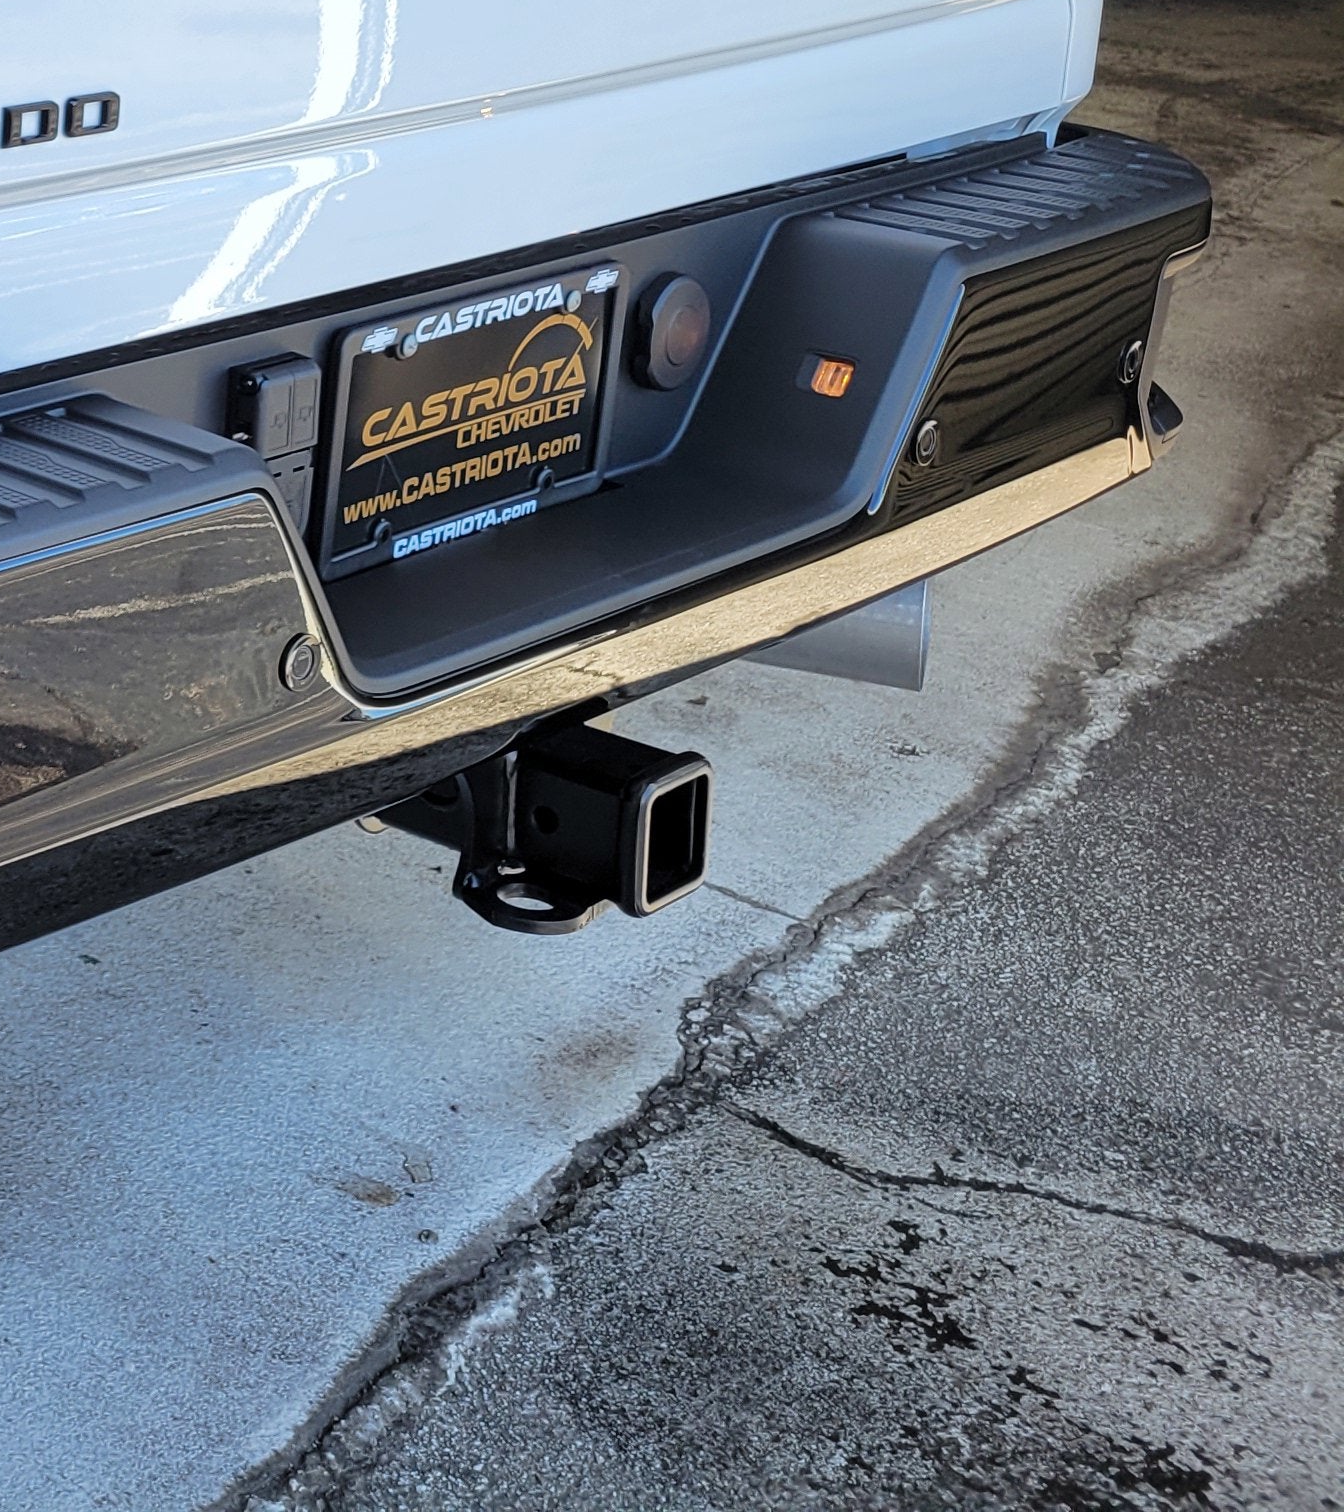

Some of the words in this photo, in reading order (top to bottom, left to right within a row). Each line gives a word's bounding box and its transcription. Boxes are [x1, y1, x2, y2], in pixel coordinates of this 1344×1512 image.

[415, 283, 563, 344] CASTRIOTA
[362, 353, 586, 448] CASTRIOTA
[456, 390, 586, 449] CHEVROLET
[343, 432, 582, 525] www.CASTRIOTA.com
[392, 498, 538, 560] CASTRIOTA.com
